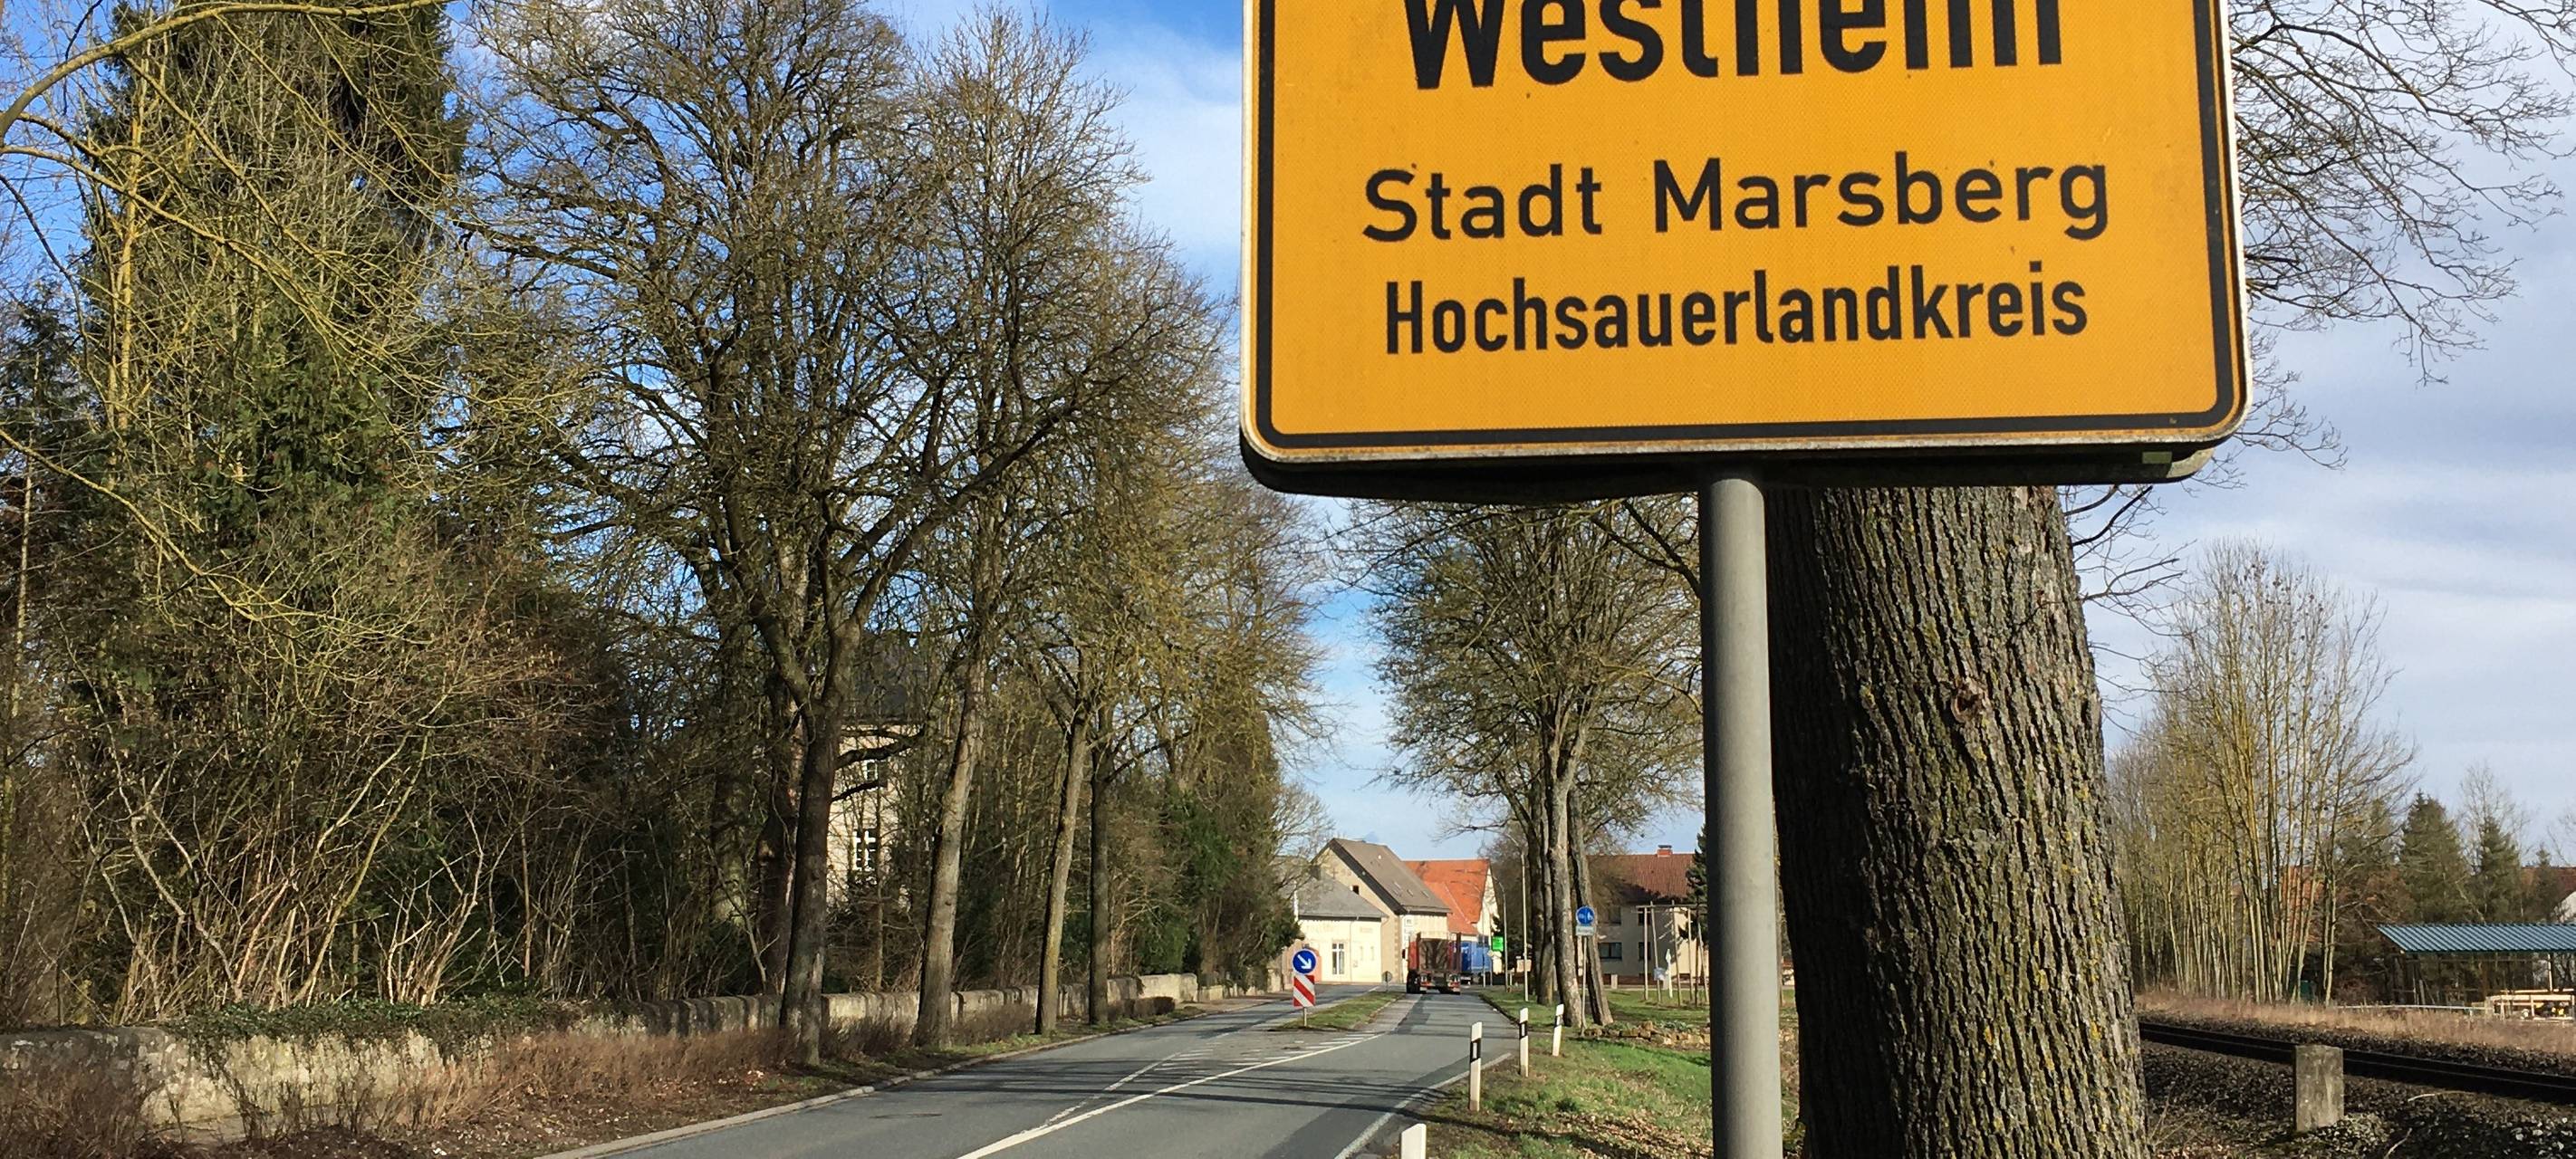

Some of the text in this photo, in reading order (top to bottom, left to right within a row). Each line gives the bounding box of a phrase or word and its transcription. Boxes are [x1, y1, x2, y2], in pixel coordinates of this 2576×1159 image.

[1362, 151, 2108, 243] Stadt Marsberg
[1386, 261, 2088, 354] Hochsauerlandkreis
